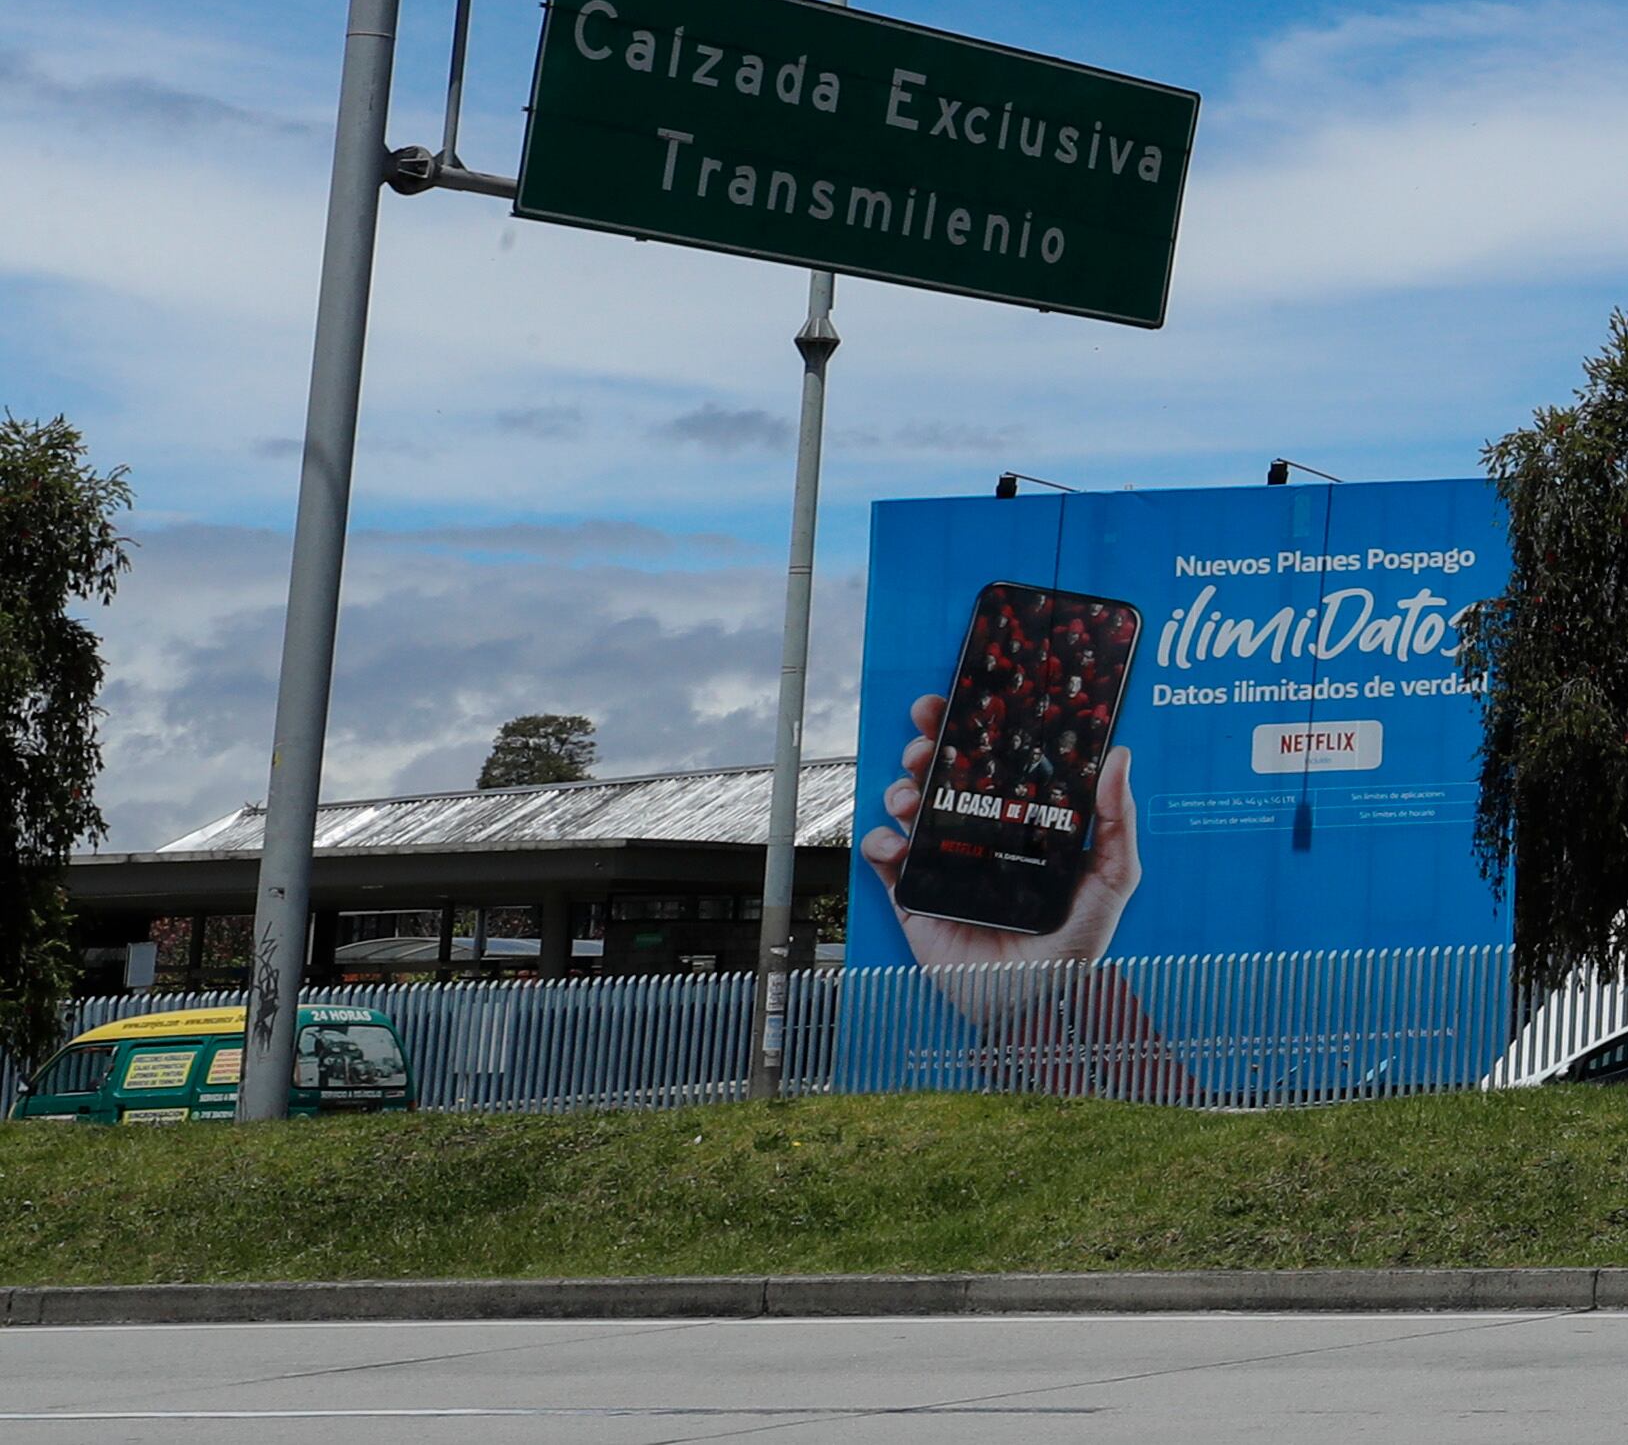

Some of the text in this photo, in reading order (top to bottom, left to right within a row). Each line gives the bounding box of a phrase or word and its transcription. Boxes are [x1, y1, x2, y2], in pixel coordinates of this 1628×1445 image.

[657, 127, 1065, 264] Transmilenio
[1175, 547, 1476, 577] Nuevos Planes Pospago
[1152, 684, 1227, 706] Datos
[1233, 677, 1359, 703] ilimitados
[1364, 674, 1395, 697] de
[1280, 732, 1355, 754] NETFLIX
[932, 787, 1074, 832] LA CASA DE PAPEL
[310, 1010, 372, 1022] 24 HORAS
